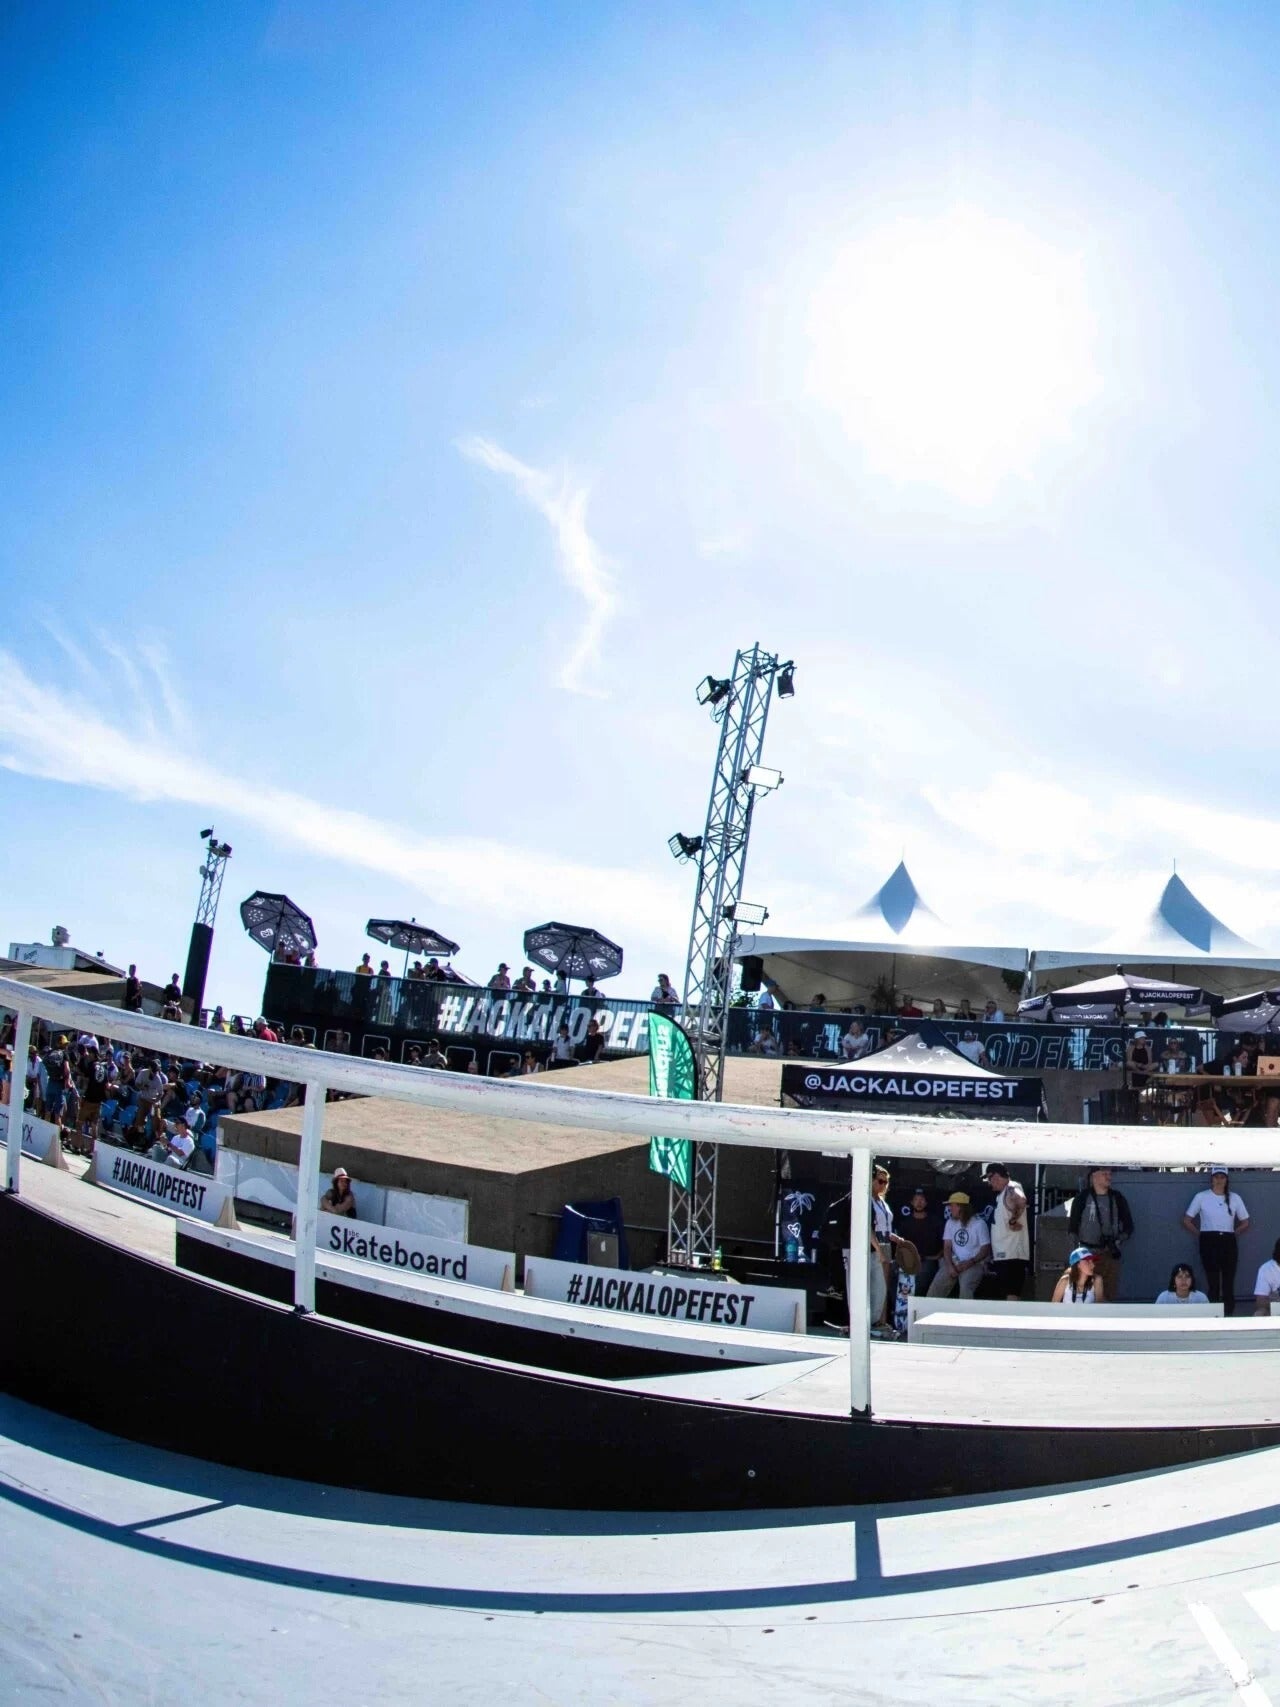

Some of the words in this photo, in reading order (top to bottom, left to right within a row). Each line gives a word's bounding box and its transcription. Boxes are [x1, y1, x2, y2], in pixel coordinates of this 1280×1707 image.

[437, 995, 651, 1050] #JACKALOPEF
[804, 1073, 1019, 1099] @JACKALOPEFEST
[113, 1157, 207, 1211] #JACKALOPEFEST
[330, 1225, 468, 1280] Skateboard
[567, 1273, 755, 1326] #JACKALOPEFEST
